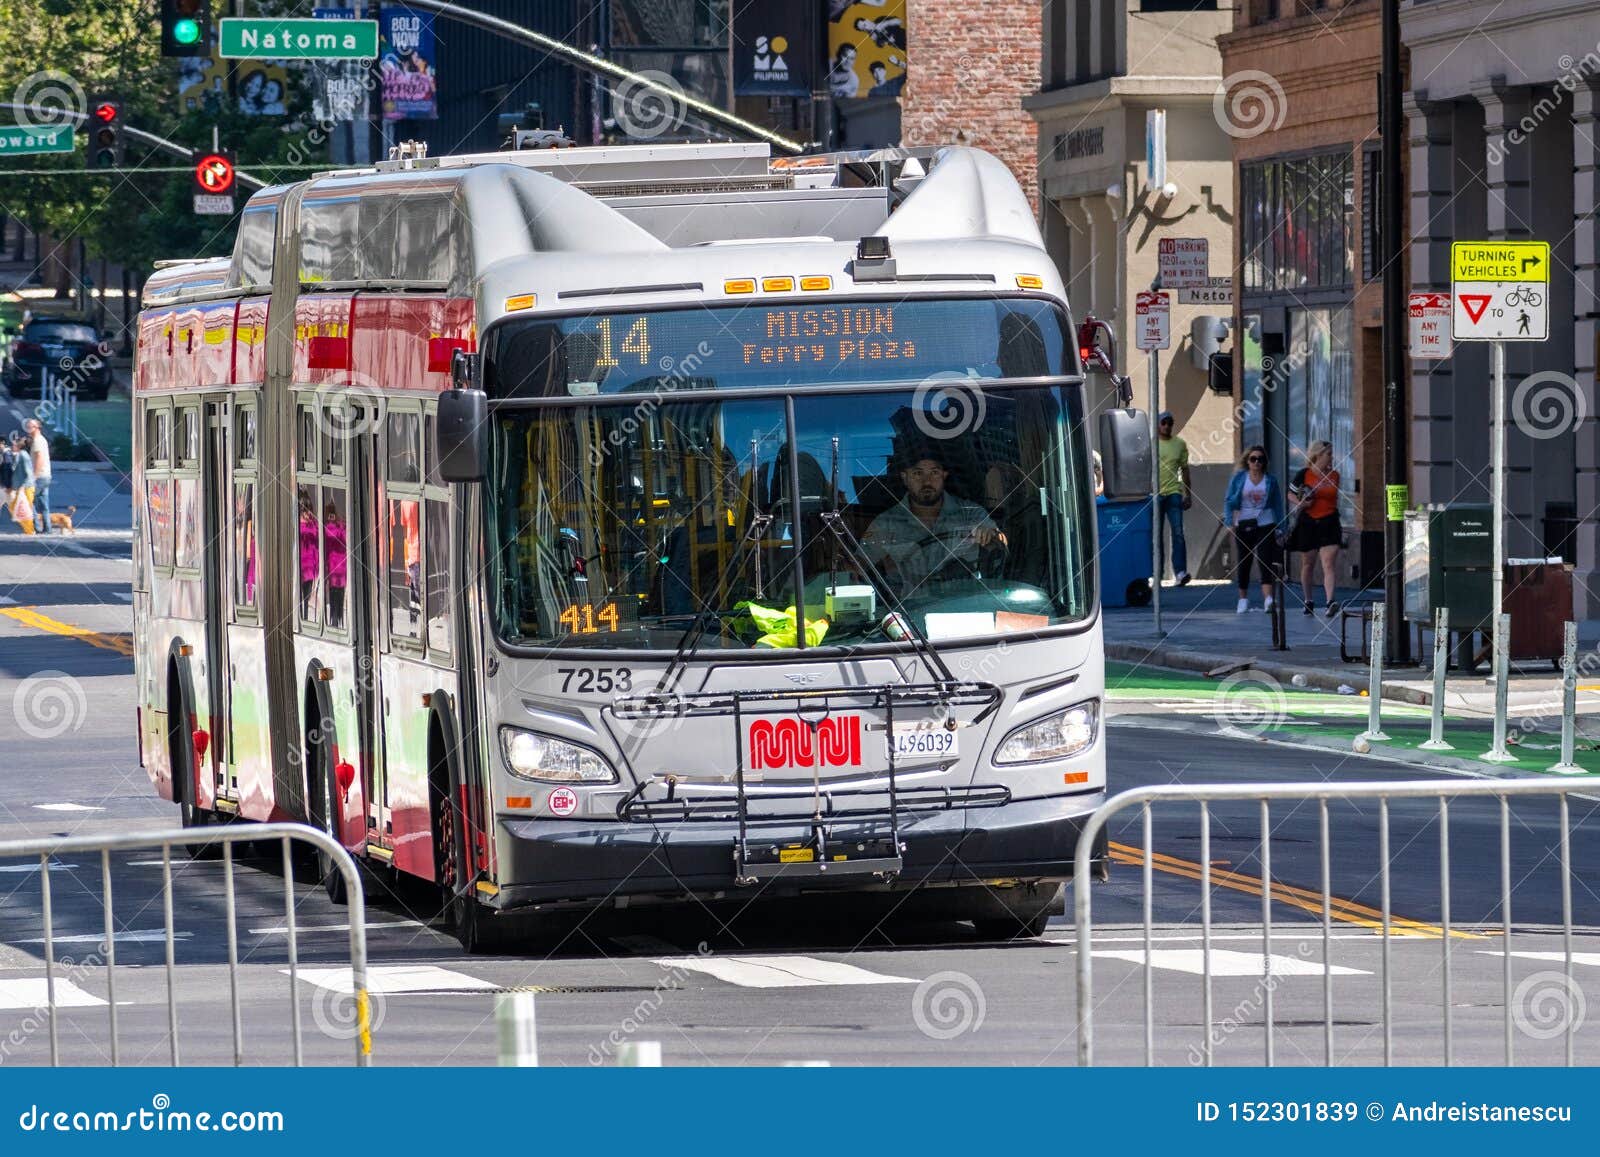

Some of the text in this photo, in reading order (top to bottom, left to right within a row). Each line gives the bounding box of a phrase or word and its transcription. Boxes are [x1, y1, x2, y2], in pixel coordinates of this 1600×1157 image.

[392, 17, 419, 31] BOLD
[241, 29, 356, 49] Natoma
[392, 32, 419, 47] NOW
[0, 132, 57, 148] oward
[1160, 241, 1174, 253] NO
[1462, 250, 1515, 261] TURNING
[1460, 266, 1517, 276] VEHICLES
[1410, 308, 1422, 316] NO
[1491, 308, 1503, 318] TO
[767, 307, 893, 338] MISSION
[1146, 317, 1160, 325] ANY
[1421, 322, 1437, 331] ANY
[595, 317, 652, 366] 14
[1420, 335, 1440, 345] TIME
[743, 340, 917, 364] Ferry Plaza
[560, 603, 619, 634] 414
[557, 667, 633, 693] 7253
[893, 733, 953, 753] 496039
